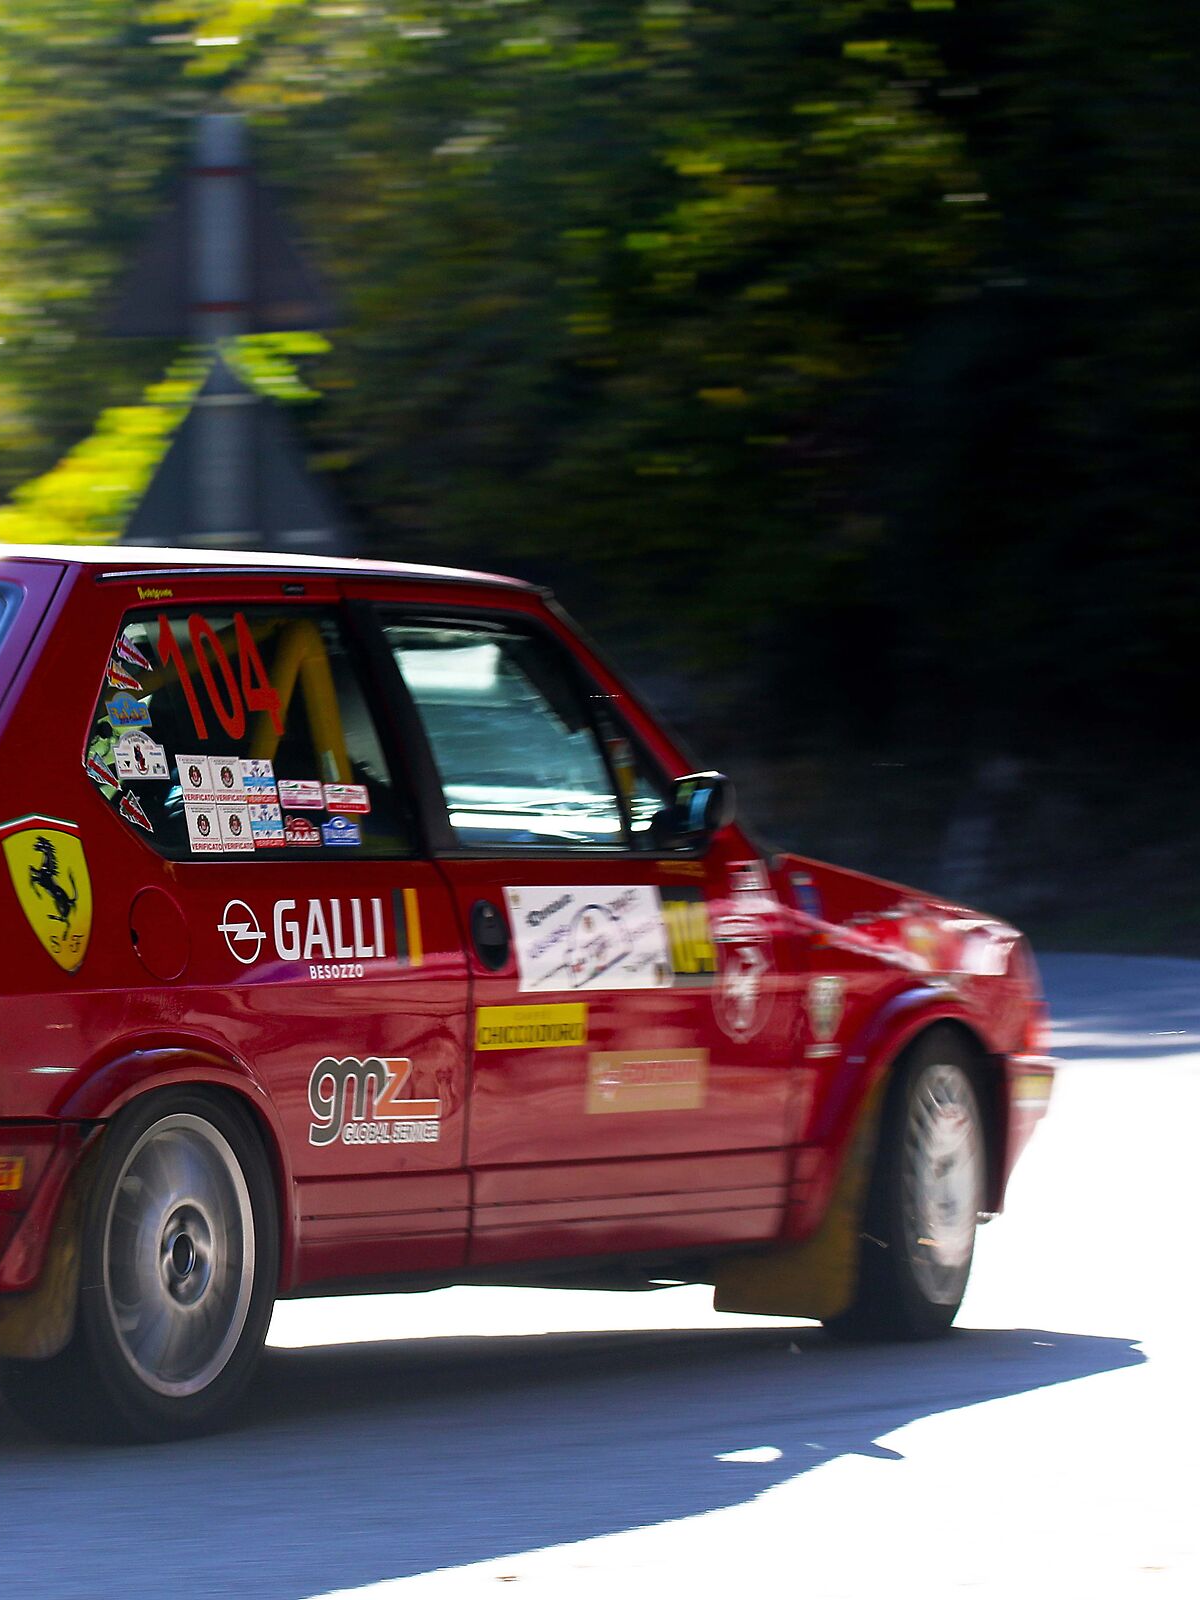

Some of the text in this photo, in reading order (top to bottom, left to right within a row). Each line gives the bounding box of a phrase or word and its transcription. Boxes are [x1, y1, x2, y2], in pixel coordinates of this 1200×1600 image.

[157, 611, 285, 740] 104
[184, 793, 215, 802] VERIFICATO
[216, 794, 246, 803] VERIFICATO
[285, 831, 320, 842] RAAB
[192, 842, 223, 851] VERIFICATO
[223, 842, 254, 850] VERIFICATO
[273, 898, 387, 961] GALLI
[309, 963, 365, 979] BESOZZO
[308, 1056, 442, 1147] gmz
[341, 1120, 440, 1145] GLOBAL SERVICE
